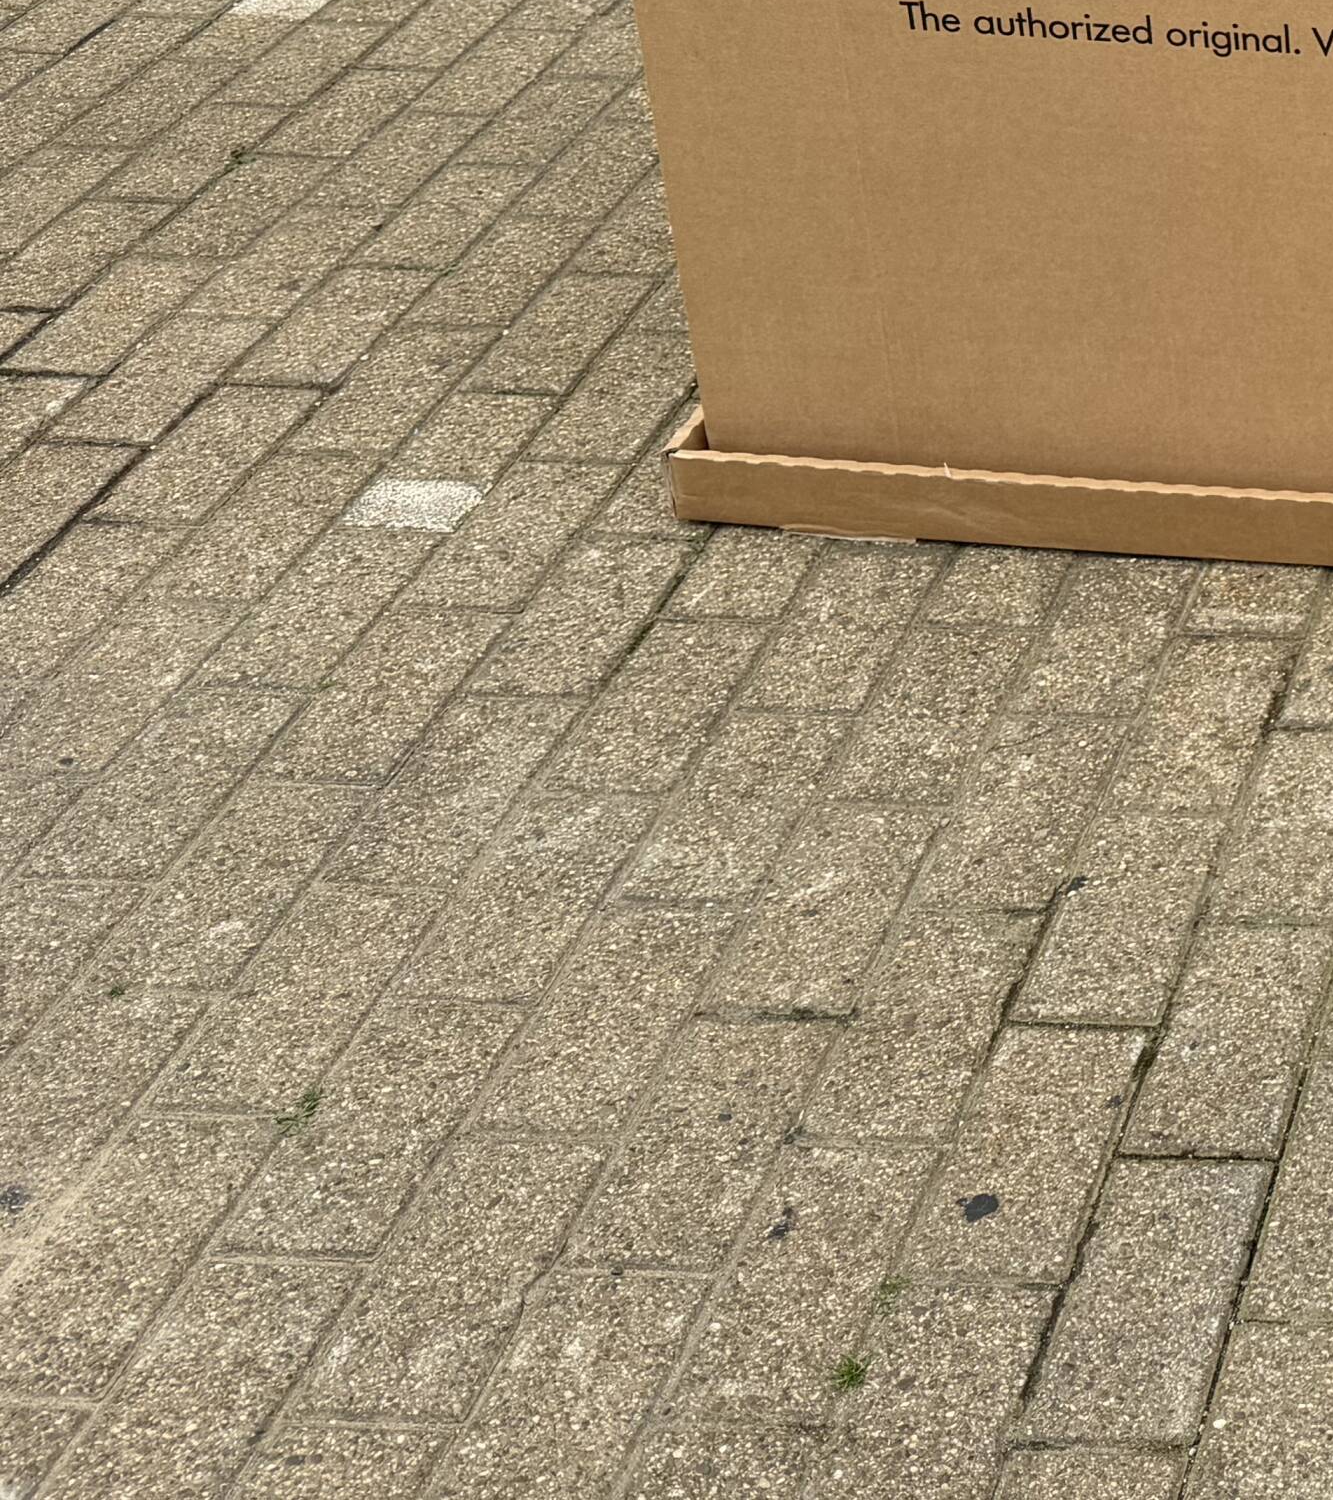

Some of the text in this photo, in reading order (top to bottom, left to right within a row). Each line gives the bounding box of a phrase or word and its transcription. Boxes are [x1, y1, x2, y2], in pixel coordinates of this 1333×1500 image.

[899, 0, 961, 33] The
[973, 6, 1153, 45] authorized
[1166, 21, 1301, 58] original.
